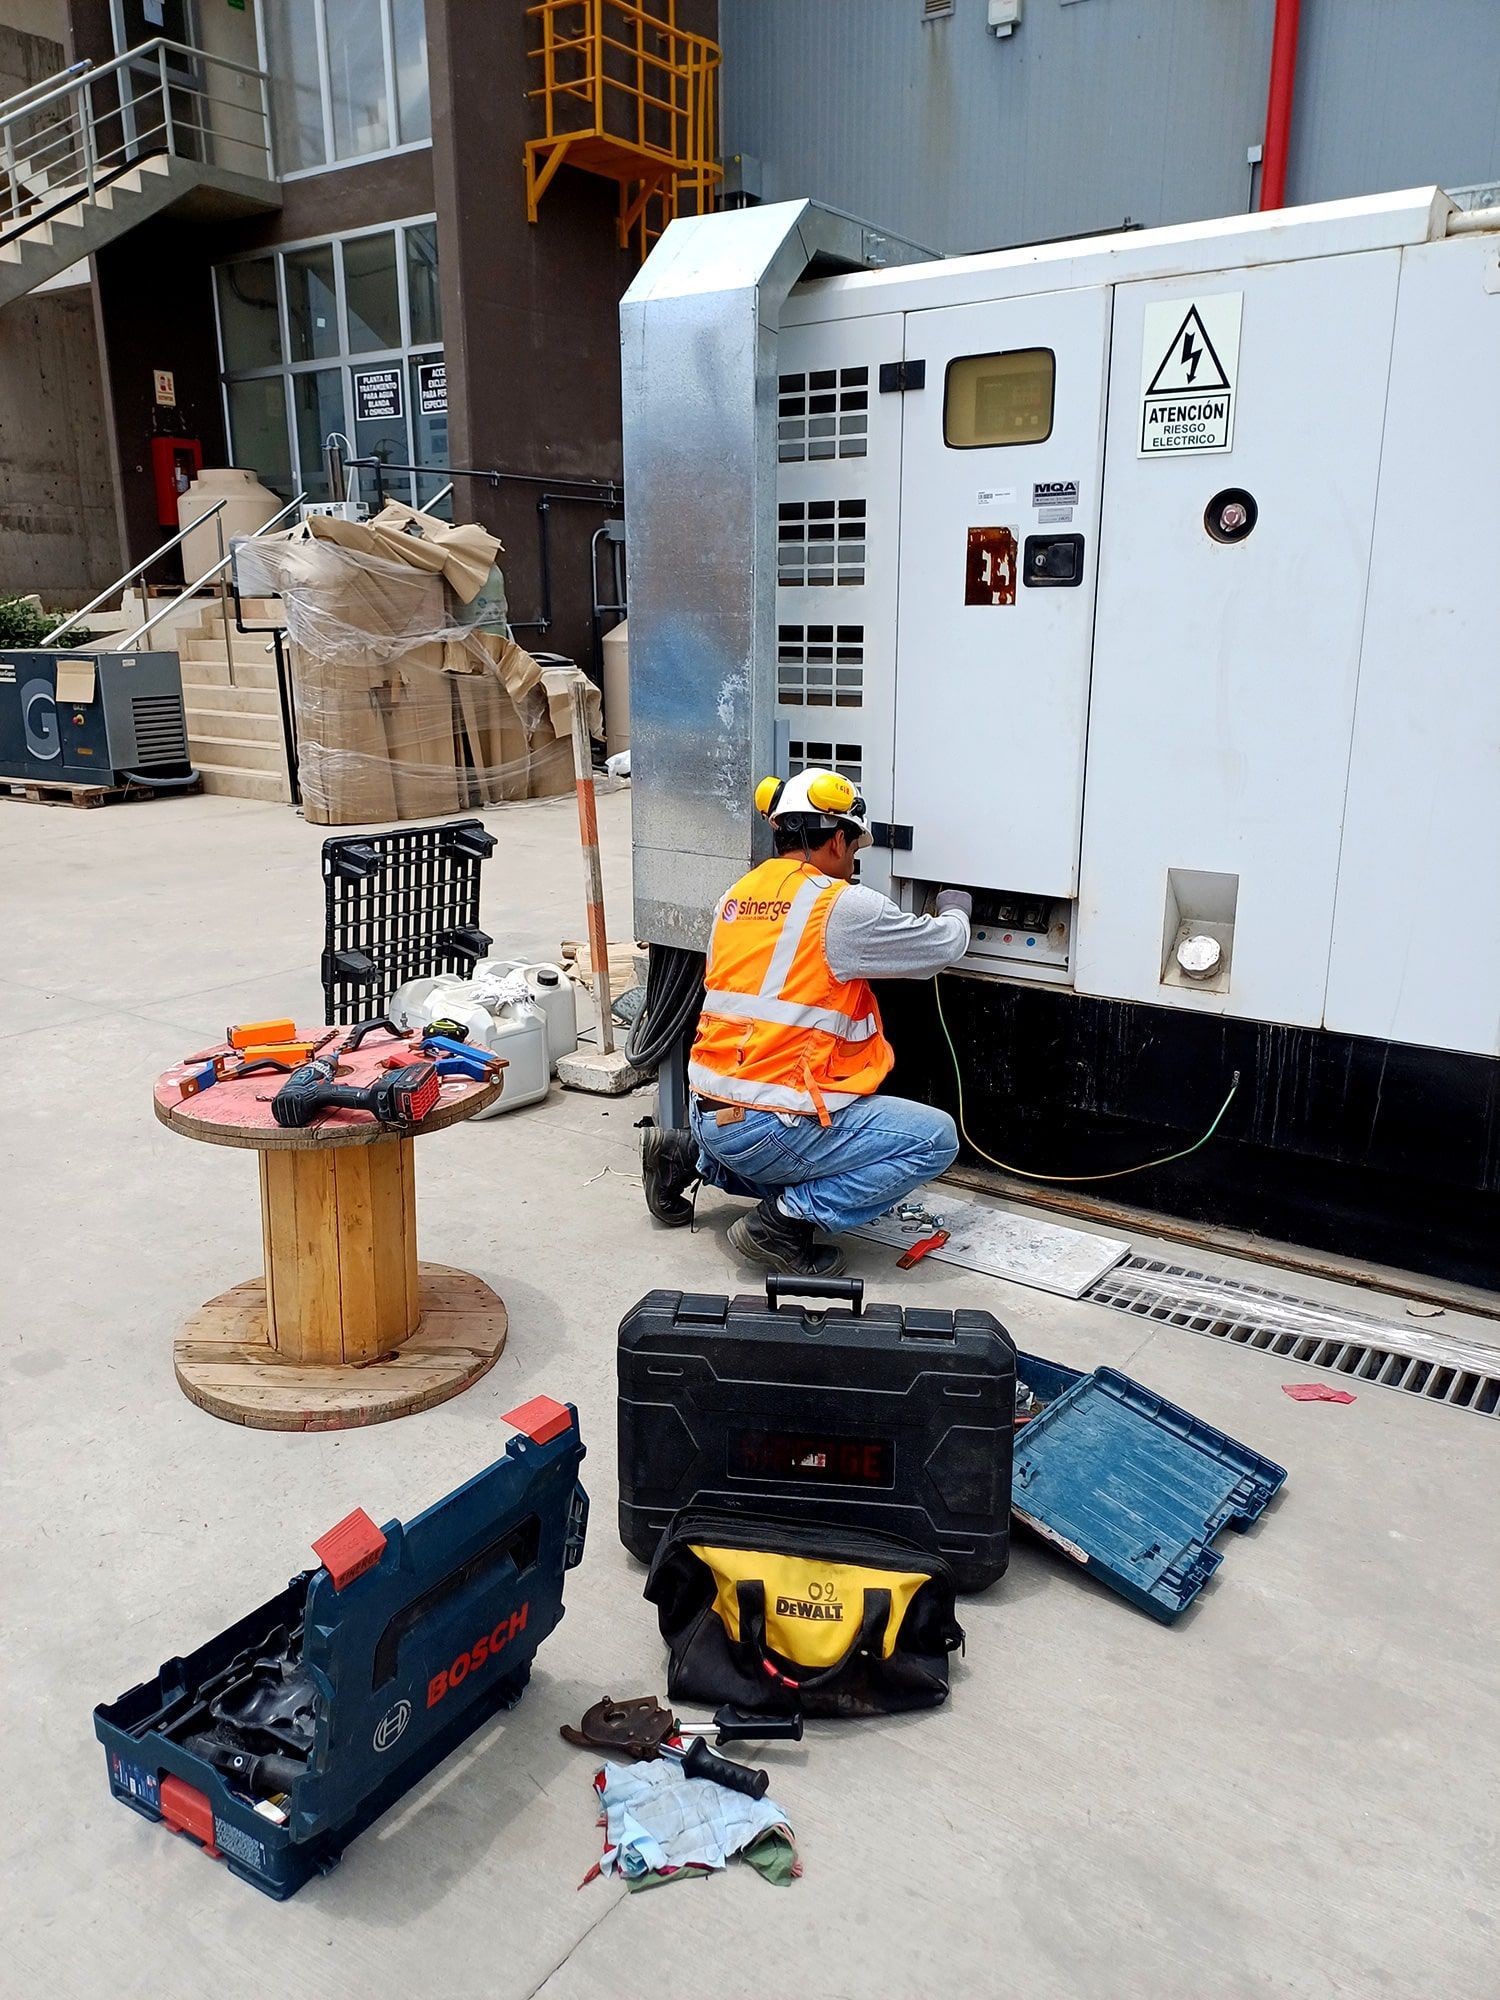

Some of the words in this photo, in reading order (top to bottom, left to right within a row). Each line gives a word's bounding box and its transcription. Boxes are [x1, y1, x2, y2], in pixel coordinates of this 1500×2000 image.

[363, 375, 383, 384] PLANTA
[363, 392, 378, 400] PARA
[422, 390, 436, 399] PARA
[1149, 400, 1224, 424] ATENCIÓN
[1163, 423, 1206, 434] RIESGO
[1152, 434, 1215, 447] ELECTRICO
[1035, 482, 1076, 493] MQA
[427, 1601, 529, 1709] BOSCH
